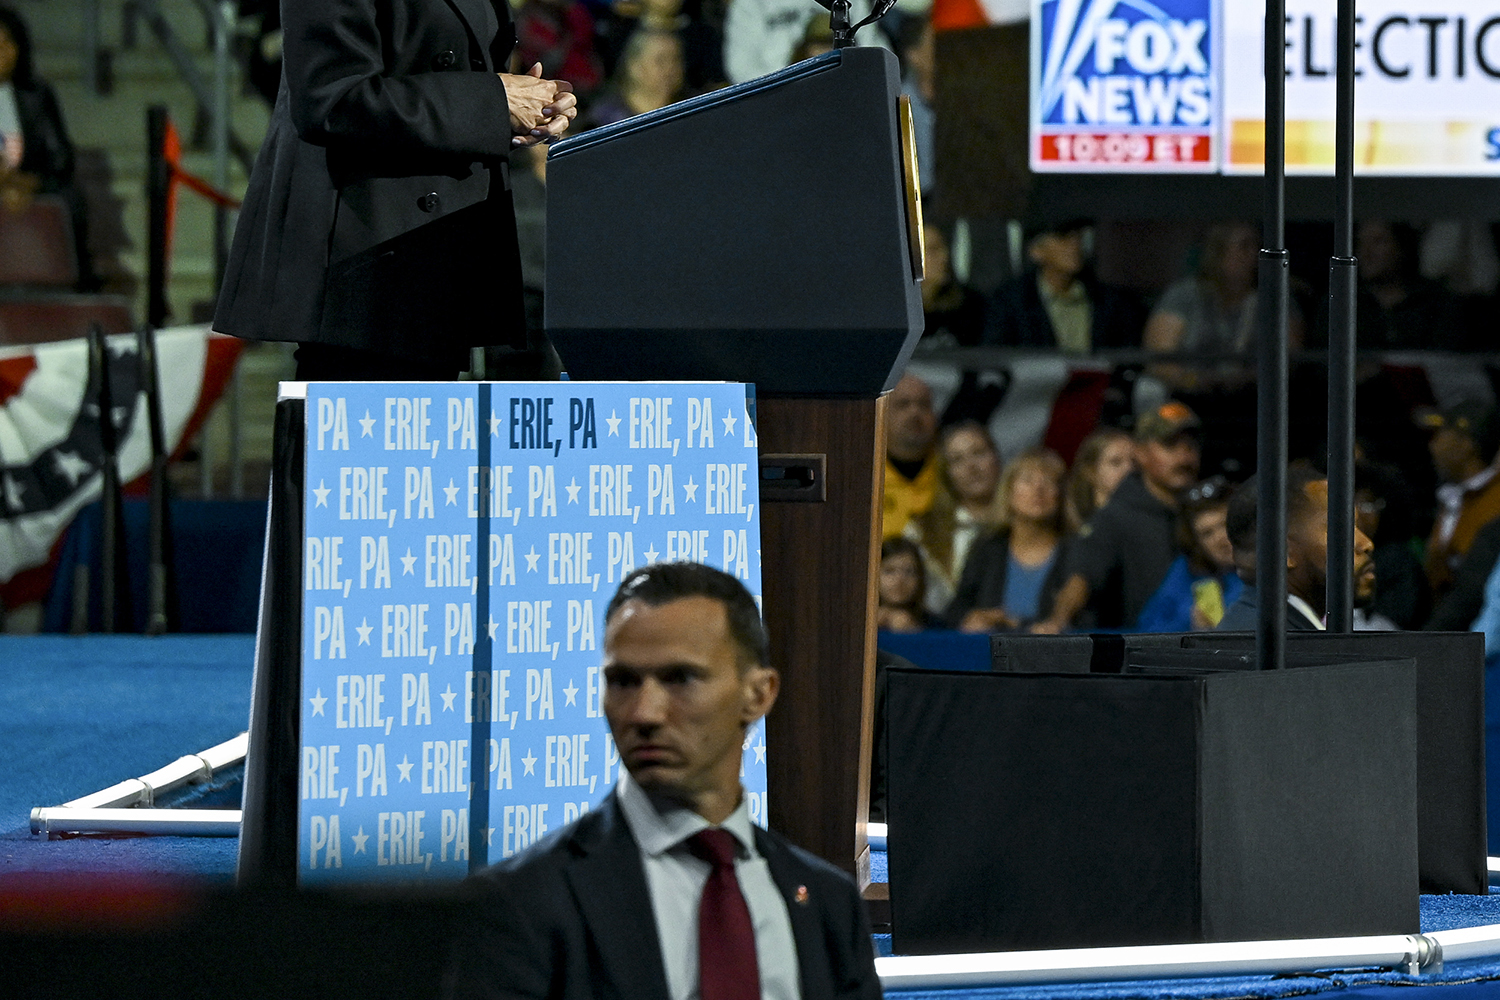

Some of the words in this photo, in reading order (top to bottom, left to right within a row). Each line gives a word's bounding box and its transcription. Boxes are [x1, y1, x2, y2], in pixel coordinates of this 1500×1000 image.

[1094, 18, 1209, 75] FOX
[1063, 74, 1210, 125] NEWS
[1153, 135, 1198, 161] ET
[317, 398, 350, 451] PA
[384, 397, 440, 459] ERIE,
[447, 397, 477, 450] PA
[509, 397, 562, 457] ERIE,
[569, 397, 598, 449] PA
[629, 397, 680, 457] ERIE,
[687, 397, 715, 448] PA
[339, 466, 397, 528] ERIE,
[404, 466, 435, 519] PA
[467, 465, 521, 526] ERIE,
[528, 465, 557, 518] PA
[588, 464, 640, 525] ERIE,
[648, 464, 675, 516] PA
[705, 463, 754, 523] ERIE,
[306, 536, 353, 598] RIE,
[360, 535, 391, 589] PA
[425, 534, 479, 595] ERIE,
[489, 533, 516, 586] PA
[548, 532, 600, 592] ERIE,
[607, 531, 635, 584] PA
[667, 530, 709, 564] ERIE
[723, 529, 749, 580] PA
[314, 605, 347, 660] PA
[381, 603, 437, 665] ERIE,
[444, 602, 474, 655] PA
[506, 600, 560, 661] ERIE,
[567, 599, 596, 652] PA
[336, 674, 394, 736] ERIE,
[401, 673, 432, 726] PA
[465, 669, 519, 731] ERIE,
[525, 668, 555, 721] PA
[302, 745, 349, 808] RIE,
[356, 743, 388, 798] PA
[421, 739, 476, 801] ERIE,
[484, 737, 513, 791] PA
[545, 734, 598, 795] ERIE,
[604, 732, 622, 785] P
[310, 815, 343, 870] PA
[377, 811, 433, 873] ERIE,
[440, 808, 469, 863] PA
[502, 803, 549, 859] ERIE
